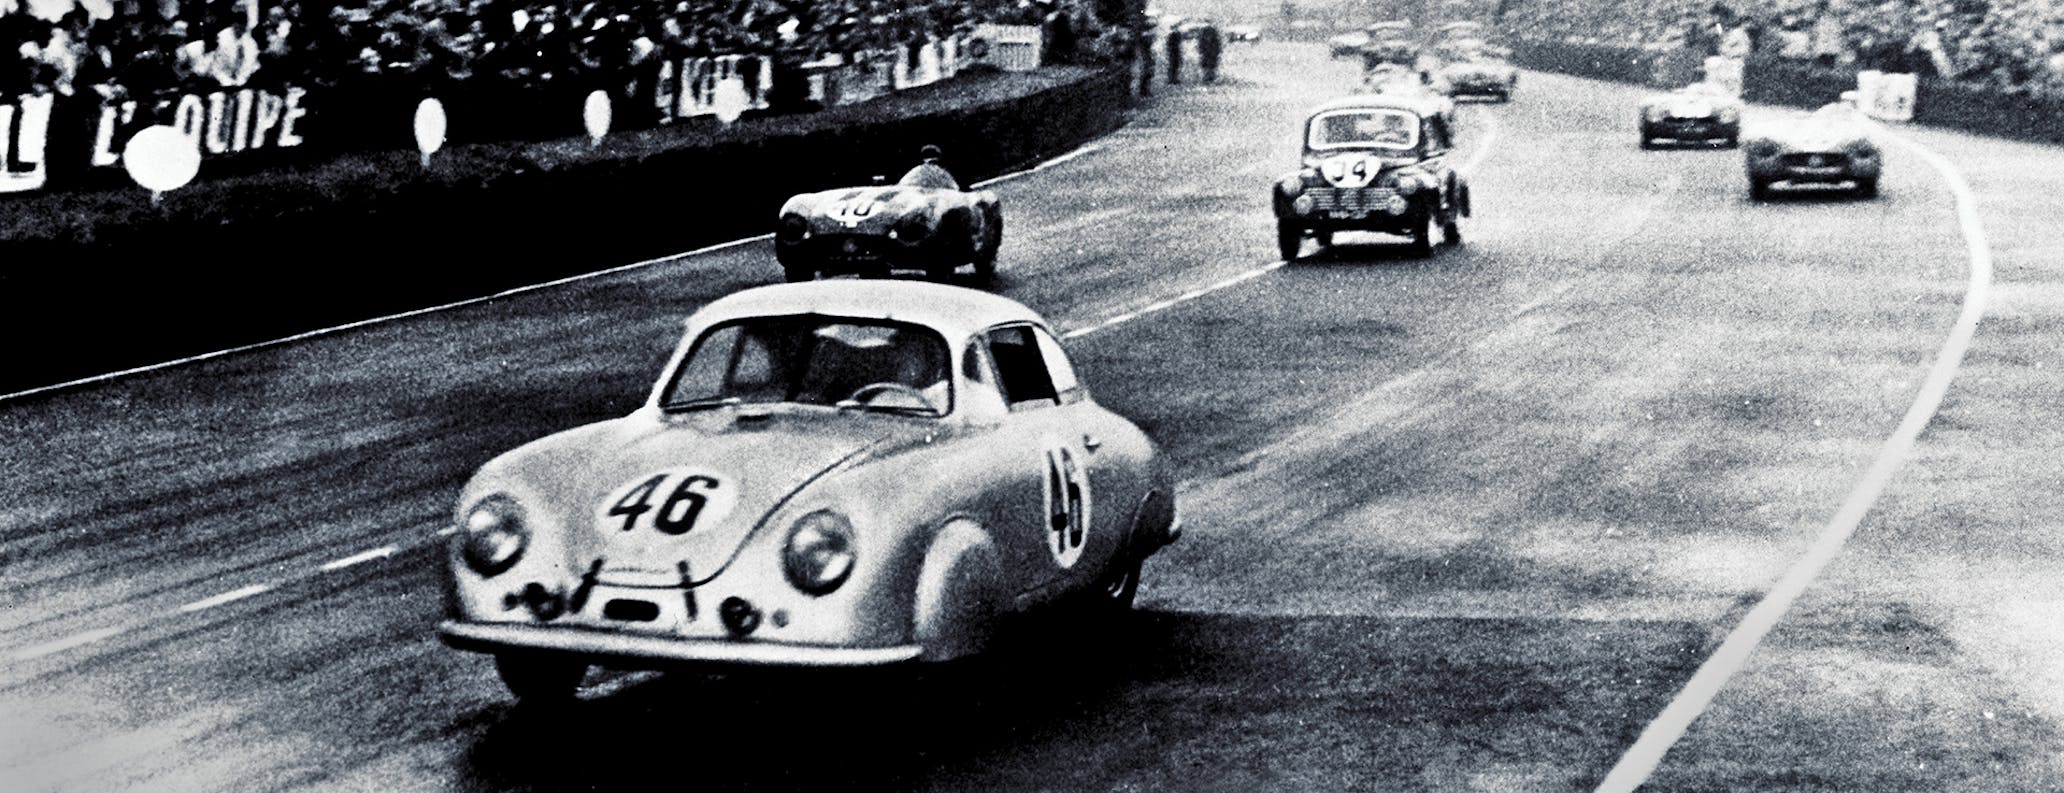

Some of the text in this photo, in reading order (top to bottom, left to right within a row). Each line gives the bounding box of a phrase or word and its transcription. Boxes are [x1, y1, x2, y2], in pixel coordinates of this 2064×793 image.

[91, 86, 307, 167] L'QUIPE
[607, 473, 720, 536] 46
[1047, 447, 1083, 554] 46
